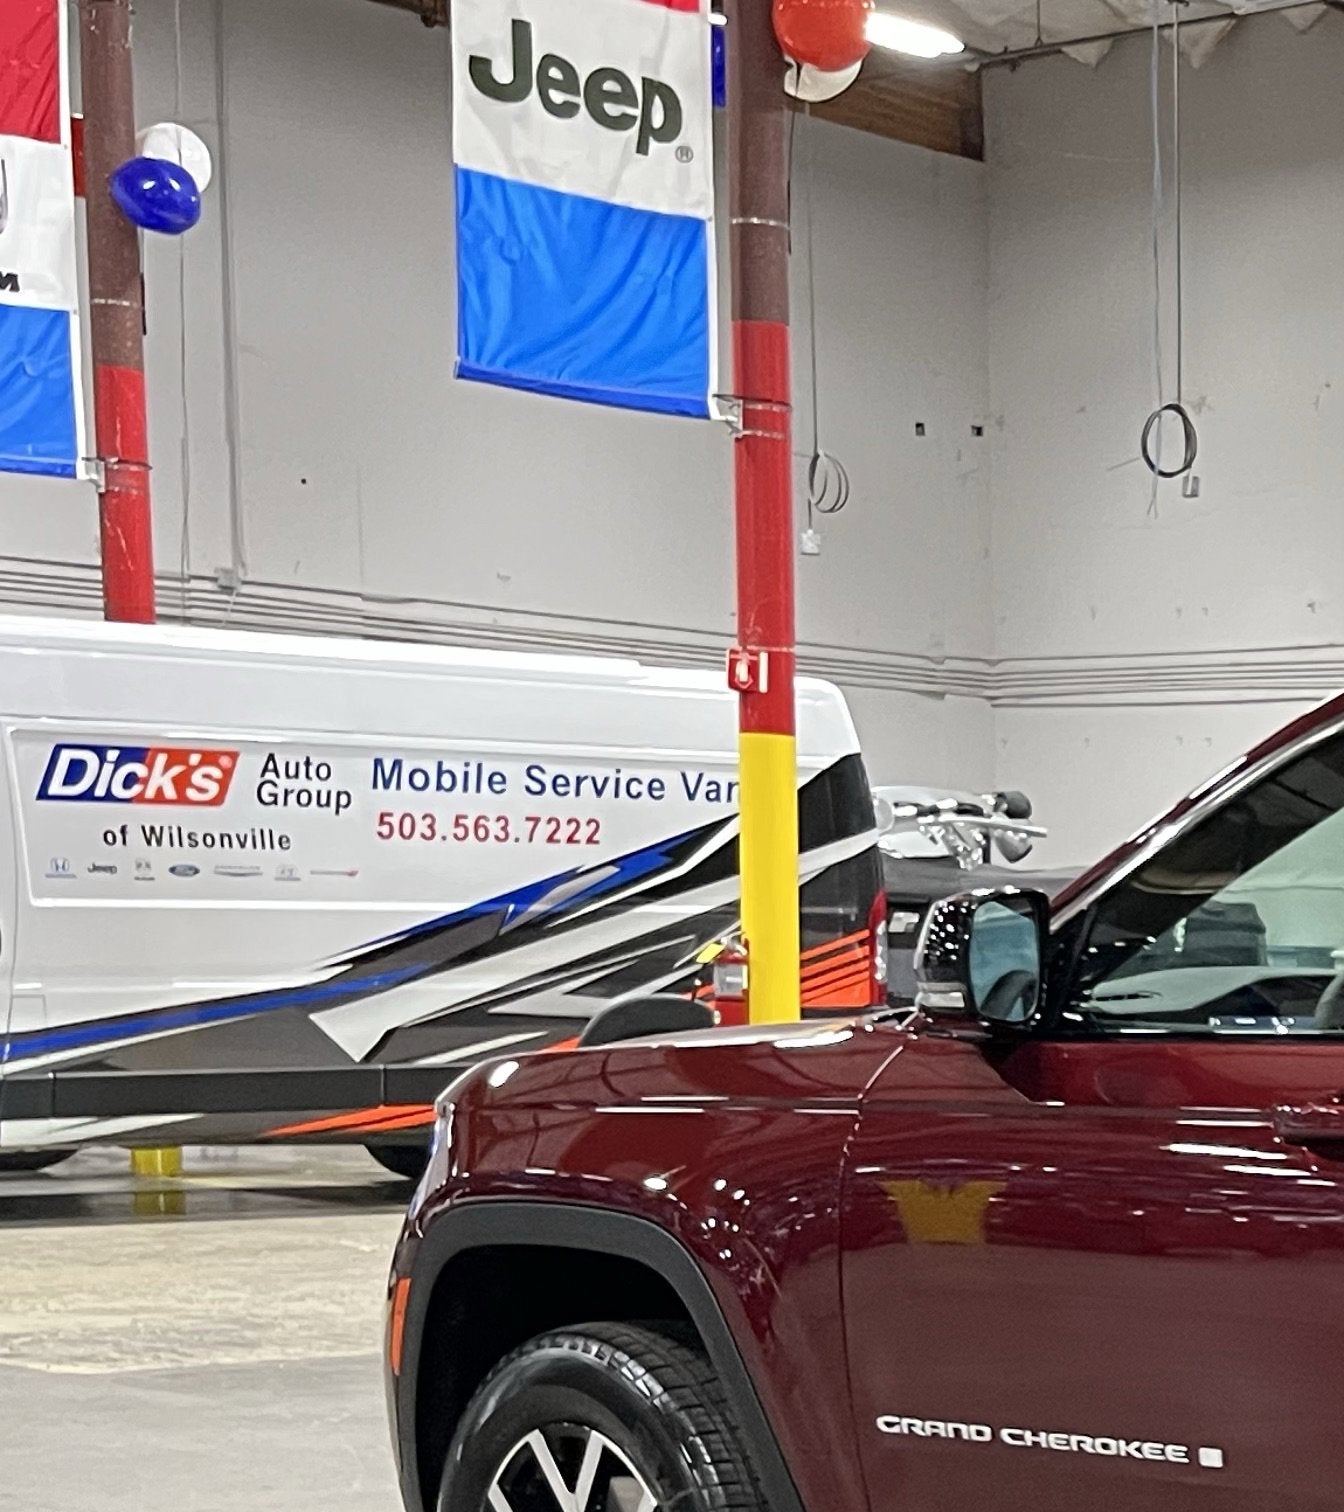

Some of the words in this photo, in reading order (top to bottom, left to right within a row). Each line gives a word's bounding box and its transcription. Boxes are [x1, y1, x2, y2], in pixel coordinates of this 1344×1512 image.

[469, 18, 682, 156] Jeep
[260, 753, 332, 781] Auto
[372, 757, 507, 797] Mobile
[524, 764, 666, 802] Service
[256, 781, 353, 815] Group
[103, 824, 128, 846] of
[140, 825, 292, 851] Wilsonville
[376, 811, 602, 845] 503.563.7222
[876, 1414, 993, 1442] GRAND
[1000, 1428, 1189, 1463] CHEROKEE
